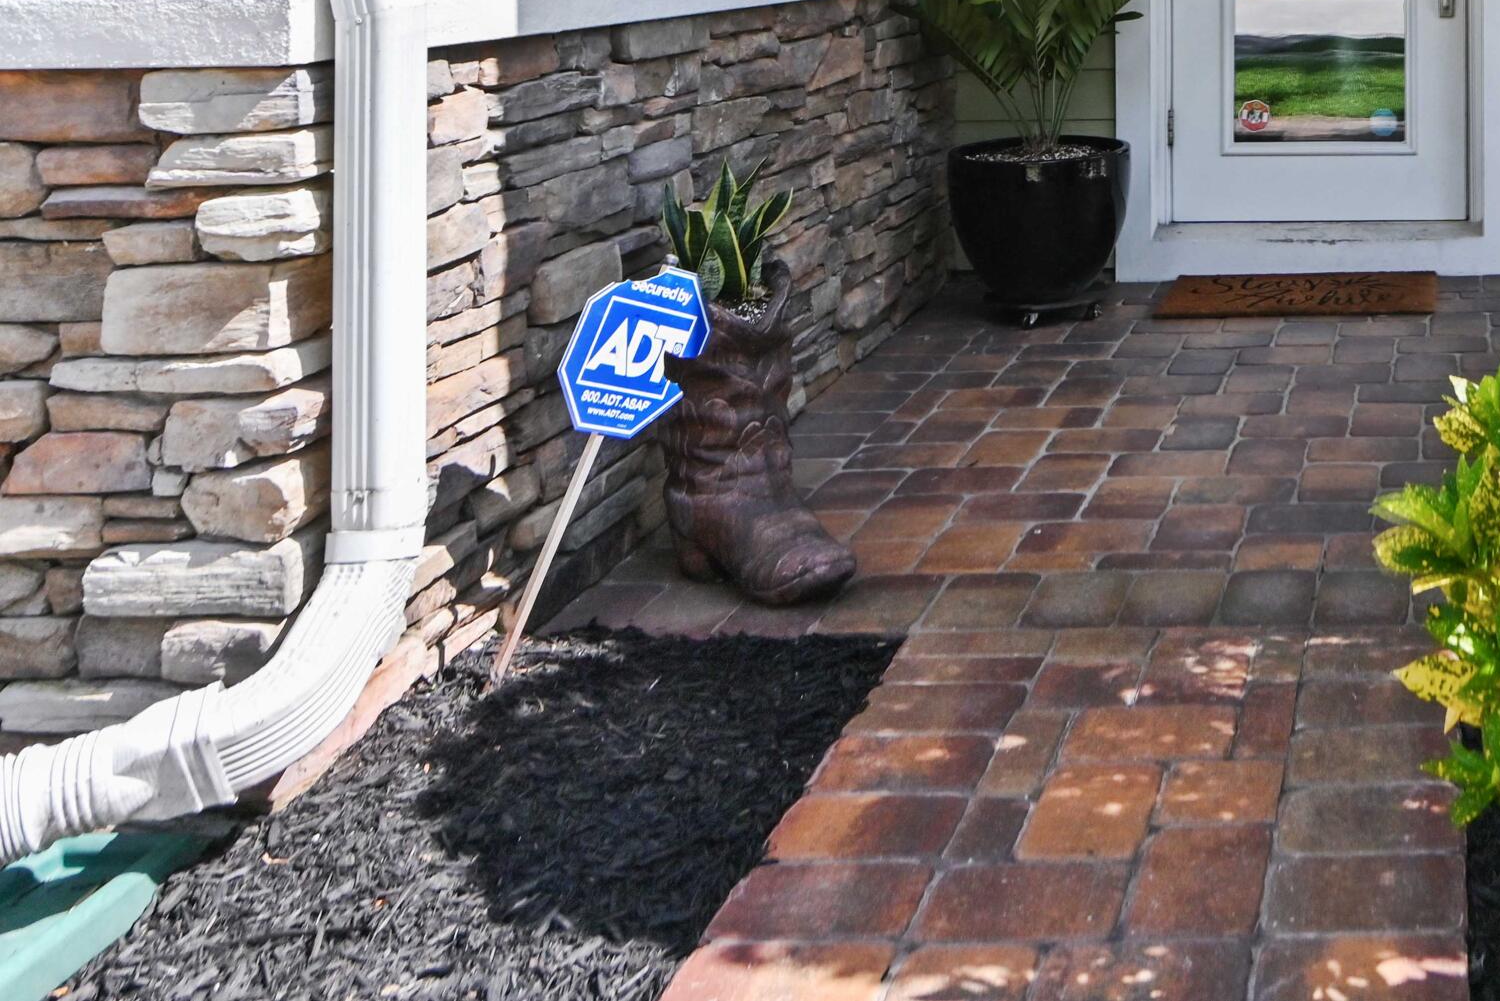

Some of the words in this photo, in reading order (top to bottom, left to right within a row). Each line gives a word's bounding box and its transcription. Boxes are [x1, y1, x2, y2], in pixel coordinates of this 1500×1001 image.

[677, 288, 693, 307] by
[585, 317, 690, 384] ADT
[581, 389, 652, 412] 800.ADT.ASAP
[587, 407, 635, 421] www.ADT.com
